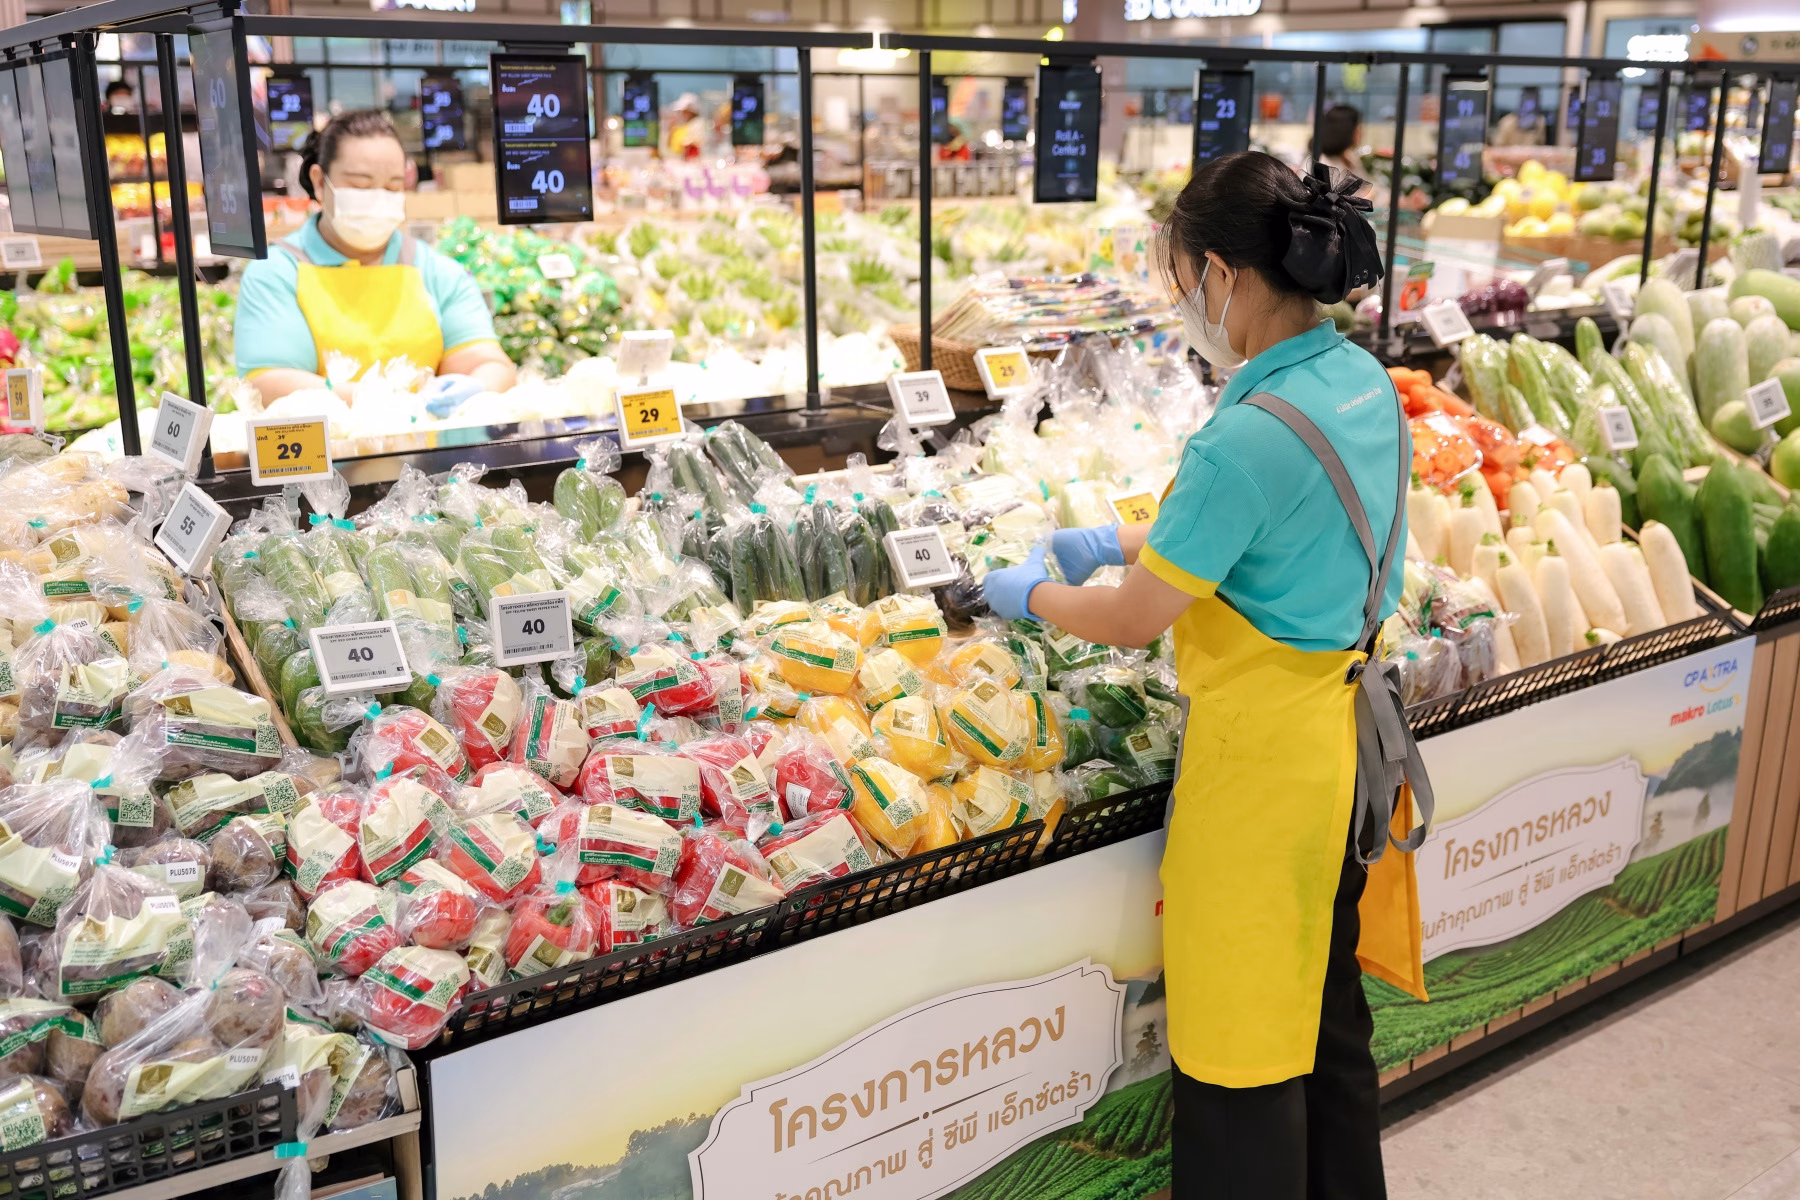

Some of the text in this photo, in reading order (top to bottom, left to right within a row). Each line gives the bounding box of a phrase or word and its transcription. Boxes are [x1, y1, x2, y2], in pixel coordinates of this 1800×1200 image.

[209, 77, 226, 109] 60
[527, 94, 560, 118] 40
[531, 170, 565, 194] 40
[220, 183, 237, 215] 55
[1000, 365, 1015, 377] 25
[915, 391, 929, 402] 39
[640, 408, 659, 423] 29
[167, 421, 181, 438] 60
[277, 442, 302, 460] 29
[1132, 508, 1149, 521] 25
[180, 515, 196, 536] 55
[915, 548, 930, 561] 40
[522, 618, 545, 635] 40
[348, 647, 373, 662] 40
[1670, 705, 1704, 726] makro
[1444, 790, 1612, 880] โครงการหลวง
[51, 853, 77, 868] PLU5078
[170, 867, 196, 877] PLU5078
[1519, 875, 1529, 906] สู่
[150, 900, 176, 909] PLU5078
[229, 1054, 258, 1063] PLU5078
[769, 1005, 1066, 1153] โครงการหลวง
[918, 1128, 934, 1169] สู่
[944, 1111, 978, 1150] ซีพี
[988, 1071, 1093, 1132] แอ็กซ์ตร้า
